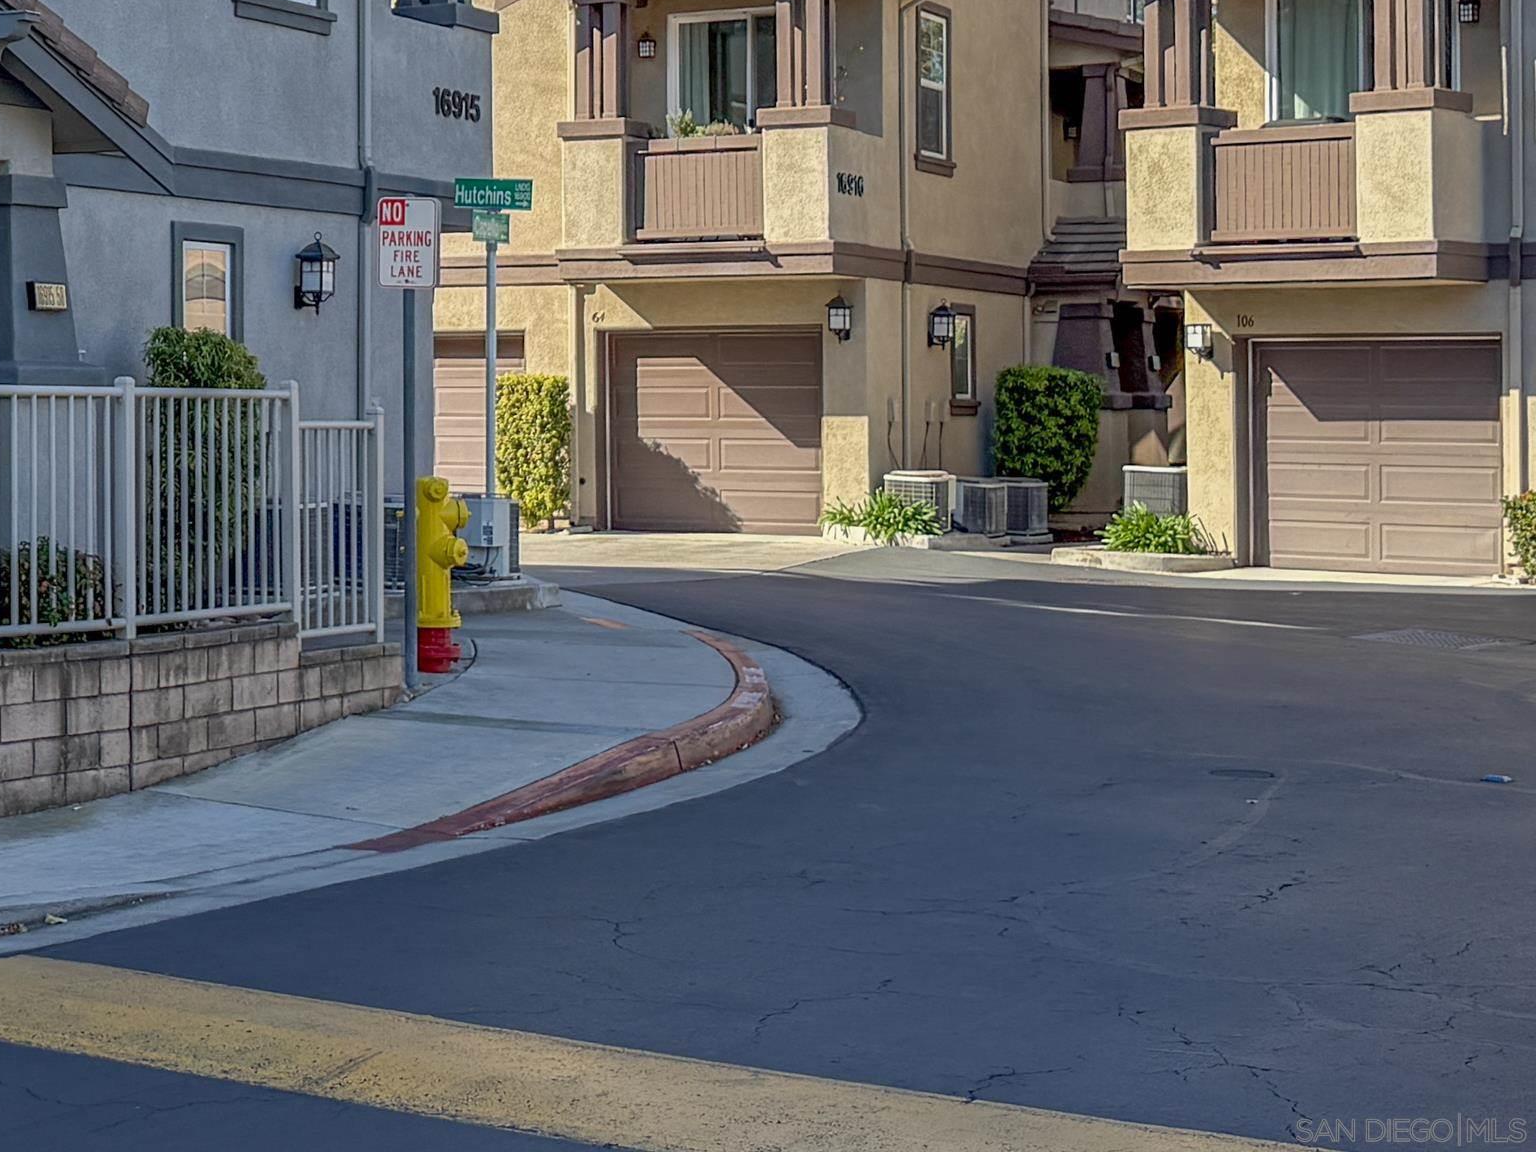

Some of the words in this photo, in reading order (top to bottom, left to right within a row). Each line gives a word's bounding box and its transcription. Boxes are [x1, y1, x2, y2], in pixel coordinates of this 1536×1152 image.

[432, 86, 481, 123] 16915
[455, 184, 512, 206] Hutchins
[382, 201, 403, 222] NO
[382, 230, 432, 247] PARKING
[393, 250, 420, 263] FIRE
[390, 265, 423, 278] LANE
[1237, 313, 1255, 329] 106
